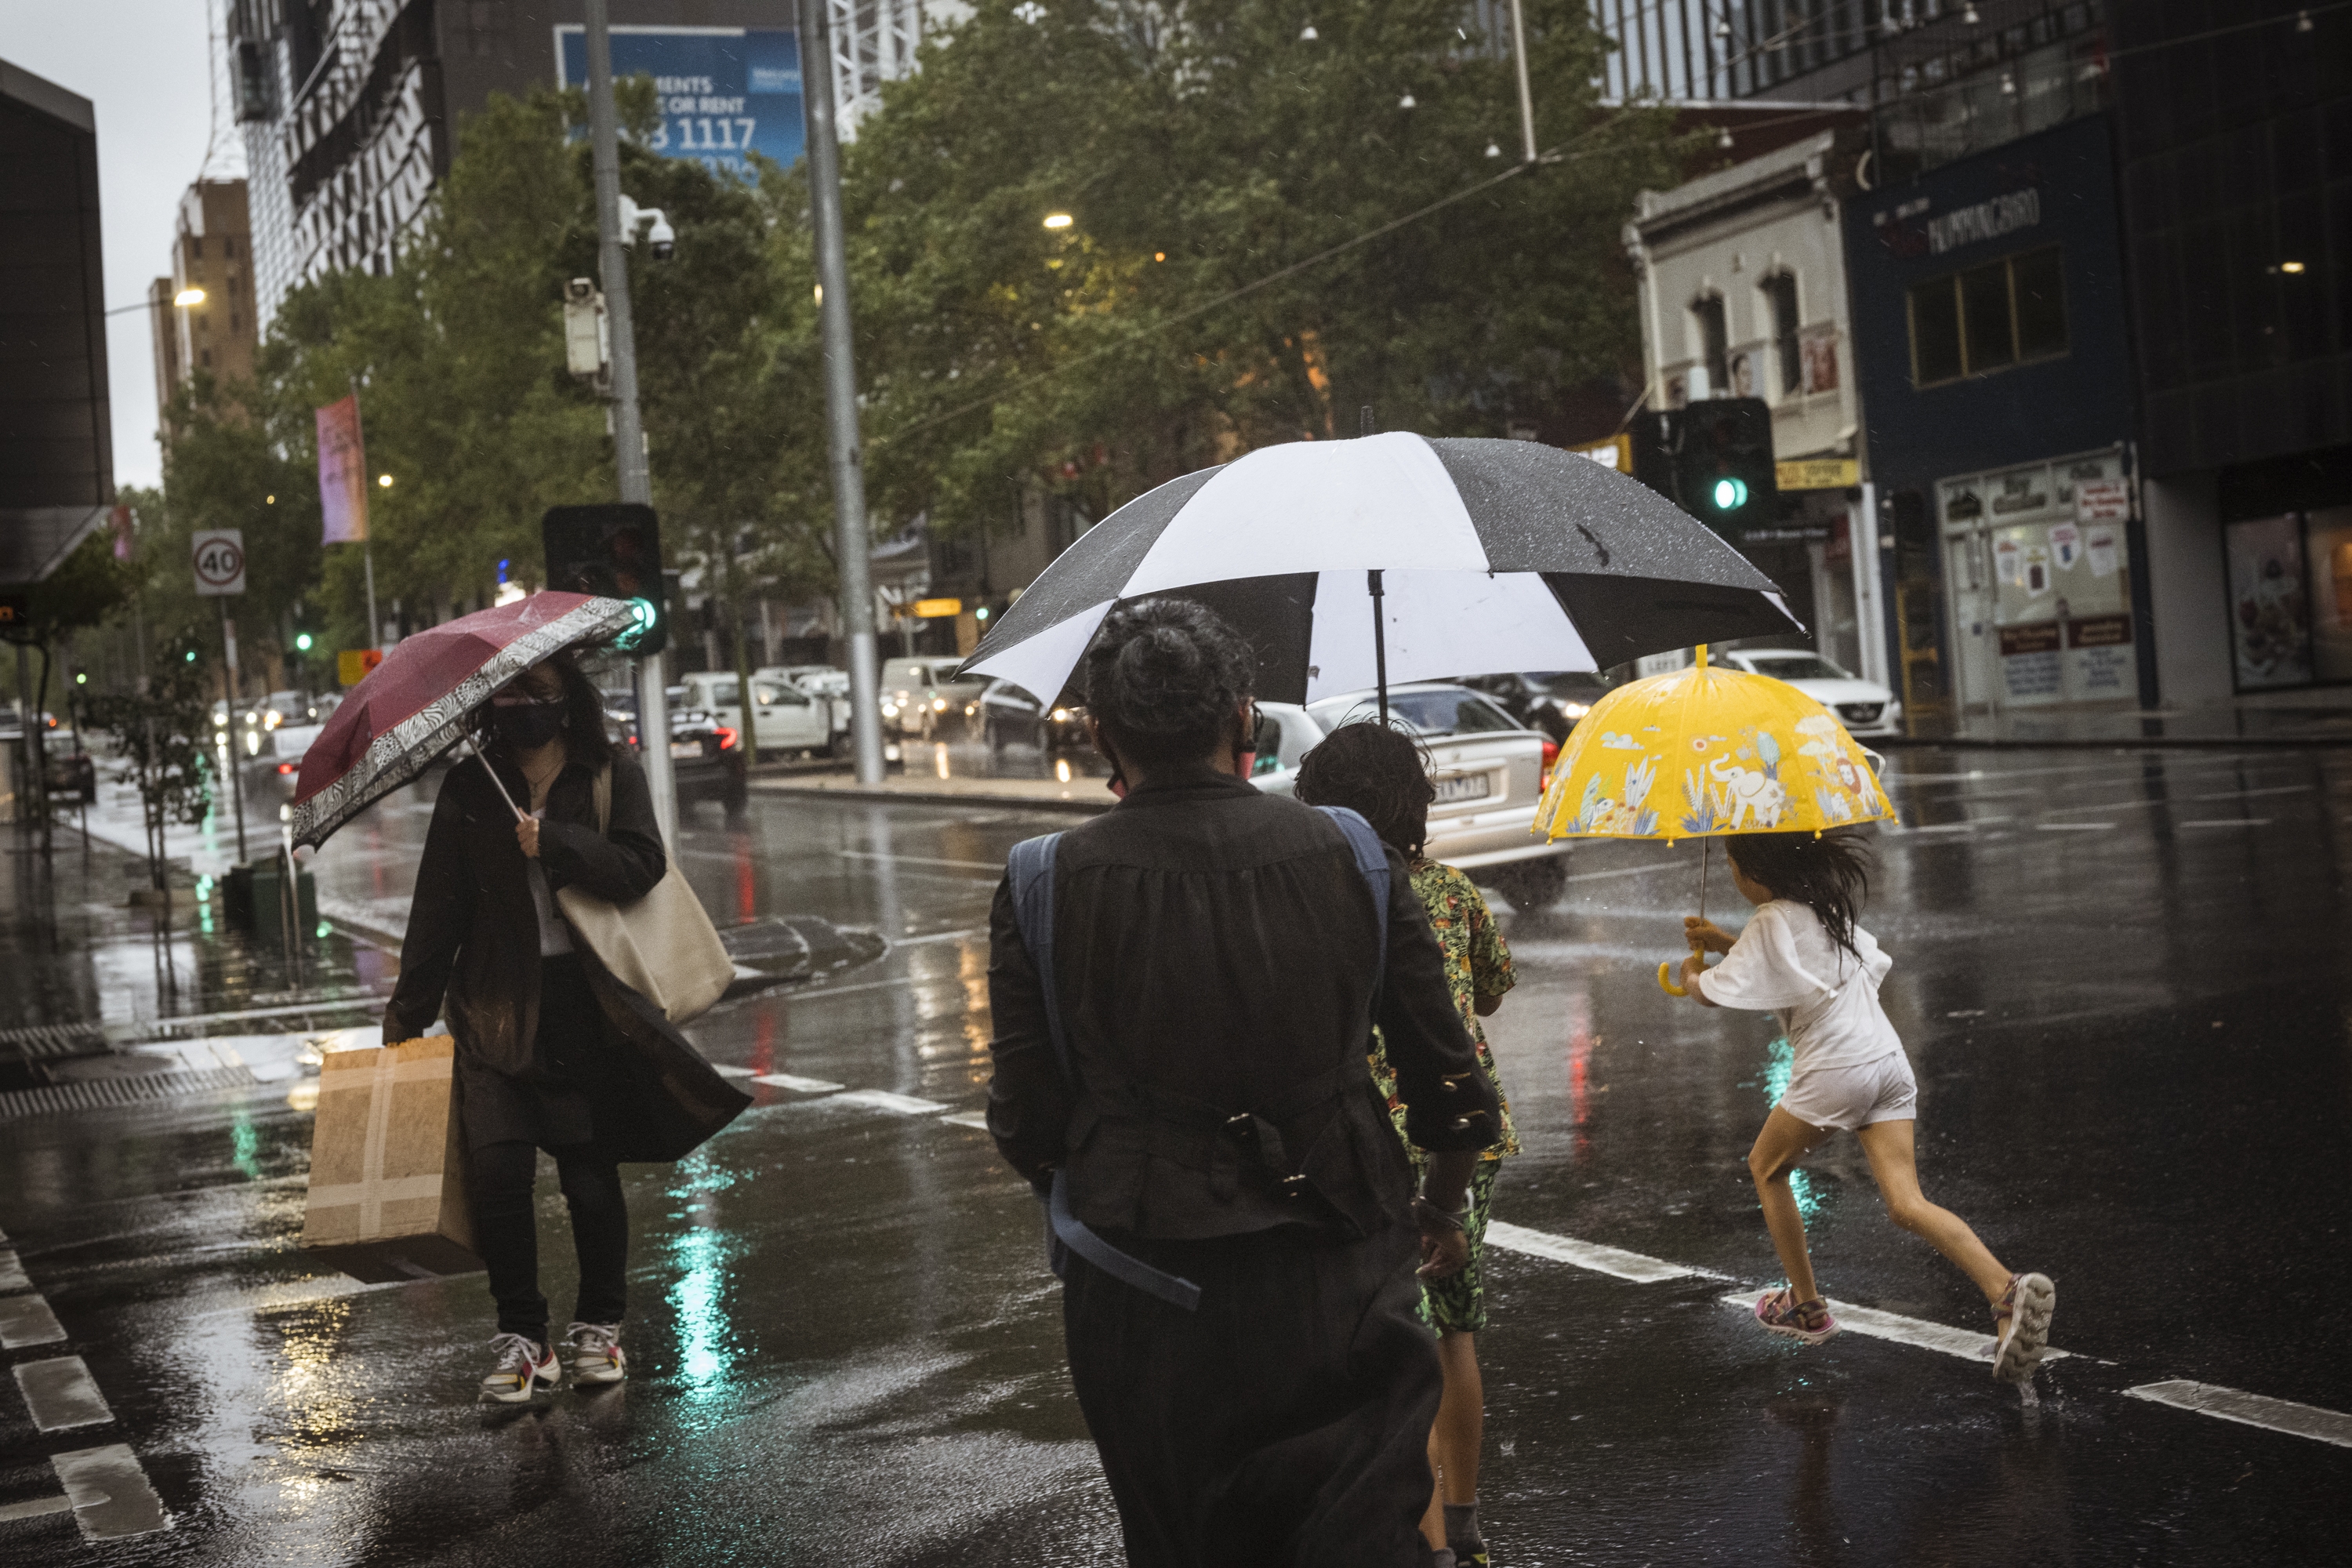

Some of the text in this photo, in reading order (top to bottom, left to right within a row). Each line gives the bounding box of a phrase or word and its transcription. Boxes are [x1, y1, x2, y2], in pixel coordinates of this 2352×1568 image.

[668, 96, 695, 114] OR
[699, 96, 746, 114] RENT
[677, 118, 756, 149] 1117
[203, 550, 236, 572] 40
